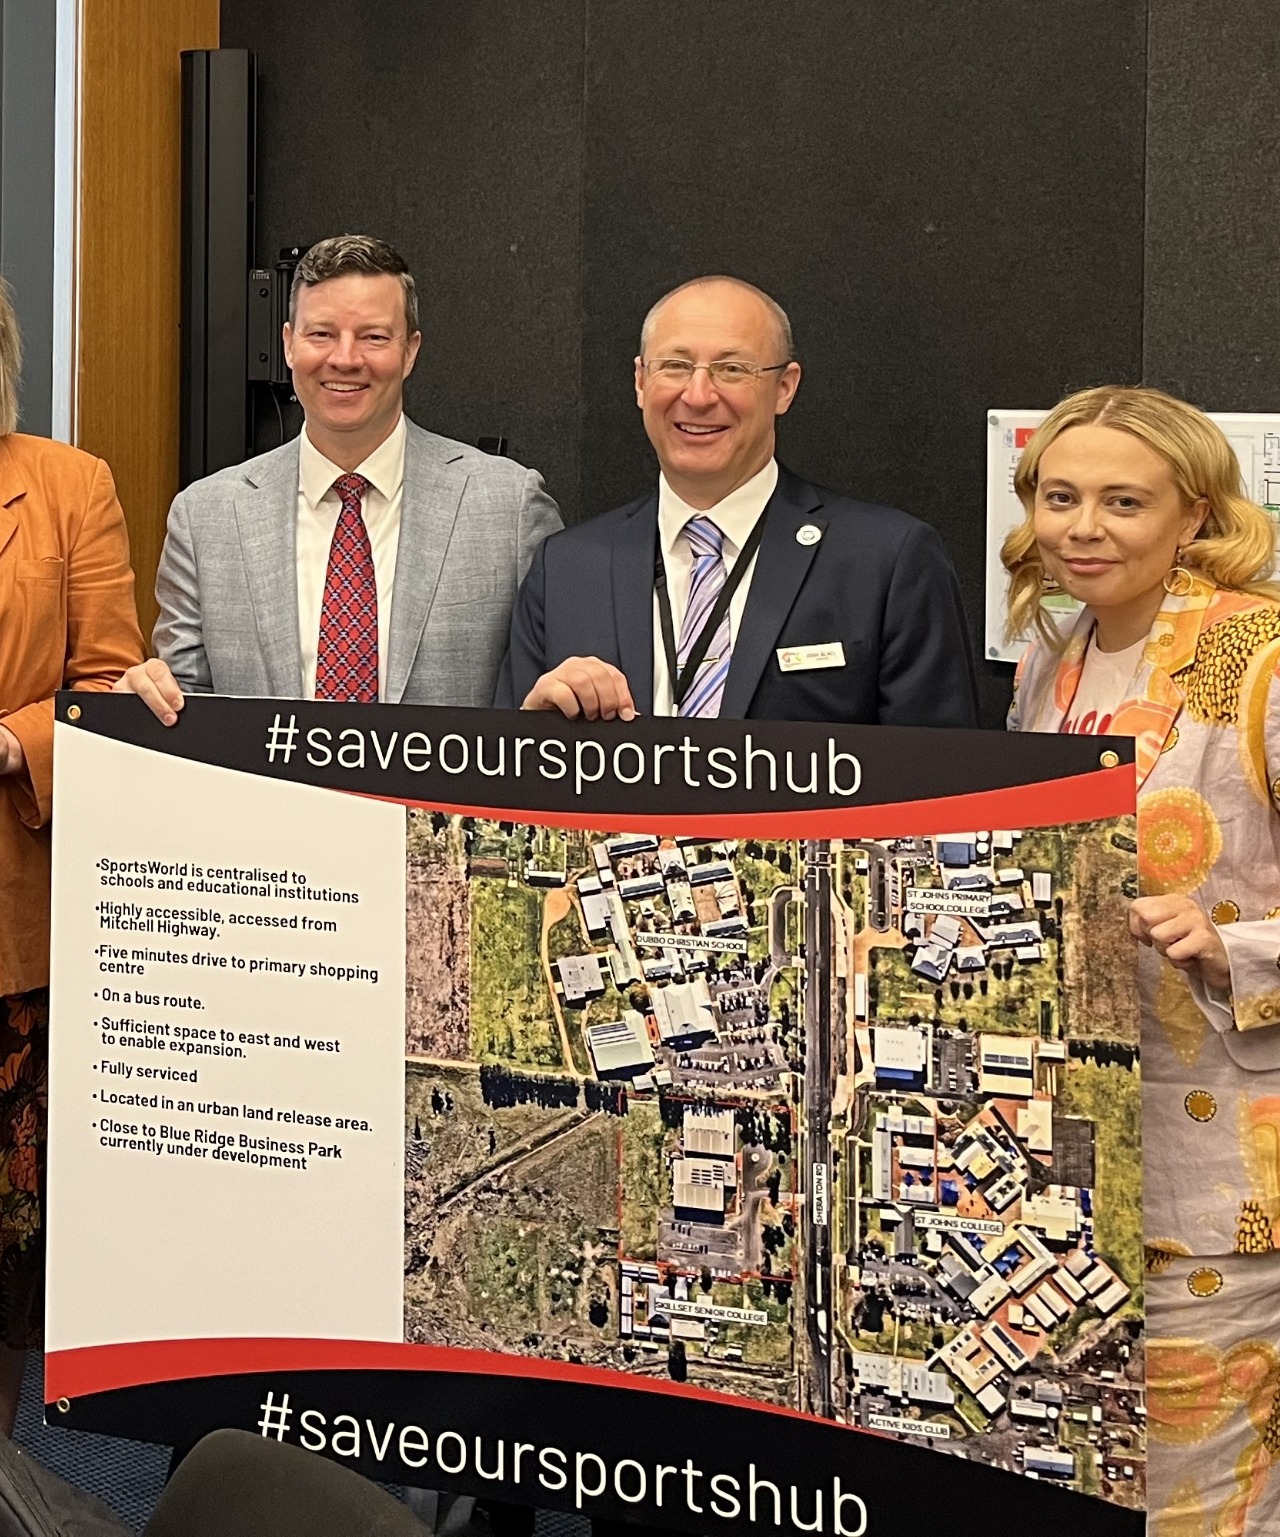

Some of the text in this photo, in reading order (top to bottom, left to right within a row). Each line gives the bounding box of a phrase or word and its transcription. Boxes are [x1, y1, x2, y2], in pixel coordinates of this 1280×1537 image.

[265, 713, 863, 796] #saveoursportshub
[101, 858, 306, 884] SportsWorld is centralised to
[100, 874, 358, 903] schools and educational institutions
[920, 891, 949, 900] JOHNS
[952, 893, 990, 902] PRIMARY
[100, 901, 336, 931] Highly accessible, accessed from
[100, 916, 219, 940] Mitchell Highway.
[637, 935, 744, 950] DUBBO CHRISTIAN SCHOOL
[99, 962, 144, 974] centre
[100, 945, 377, 983] Five minutes drive to primary shopping
[101, 1061, 197, 1082] Fully serviced
[101, 1090, 372, 1131] Located in an urban land release area.
[928, 1218, 958, 1228] JOHNS
[961, 1221, 1001, 1232] COLLEGE
[694, 1306, 725, 1317] SENIOR
[727, 1310, 765, 1322] COLLEGE
[869, 1418, 948, 1436] ACTIVE KIDS CLUB
[258, 1391, 868, 1537] #saveoursportshub
